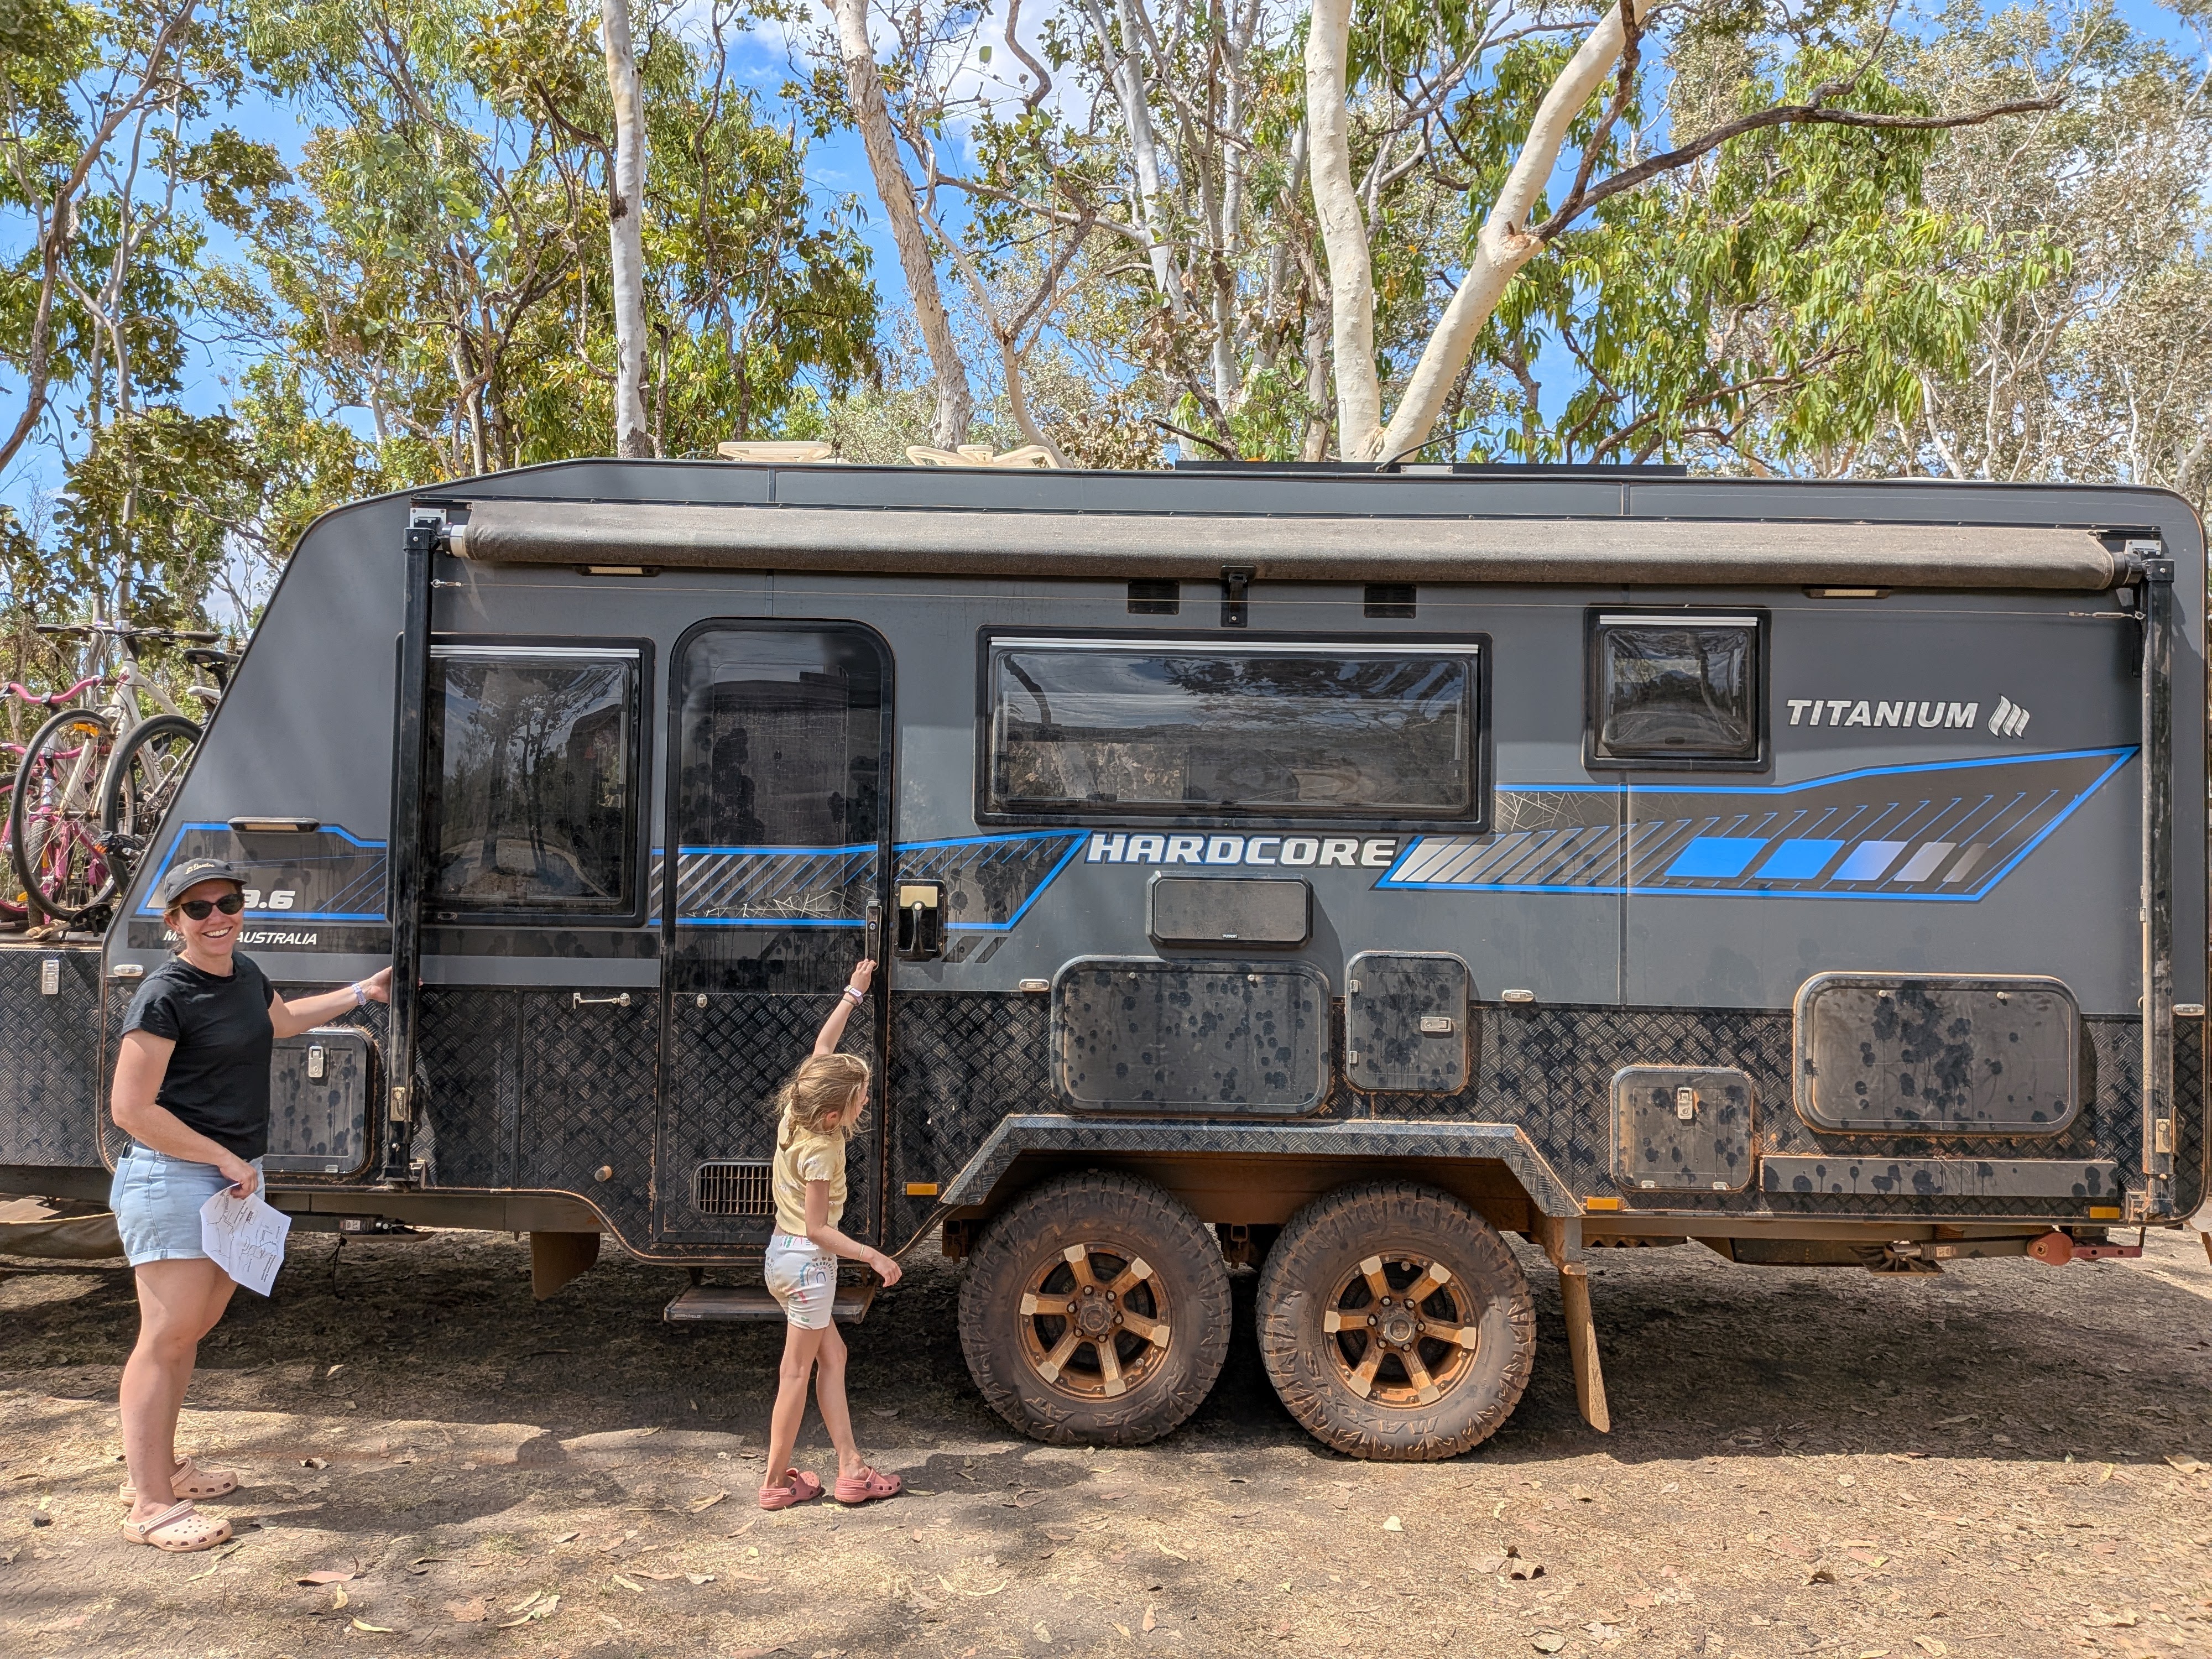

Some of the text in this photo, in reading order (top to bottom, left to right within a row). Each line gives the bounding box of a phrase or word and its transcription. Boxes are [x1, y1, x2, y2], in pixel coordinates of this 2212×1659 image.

[1786, 699, 1979, 729] TITANIUM
[1085, 833, 1397, 867] HARDCORE
[236, 931, 317, 945] AUSTRALIA
